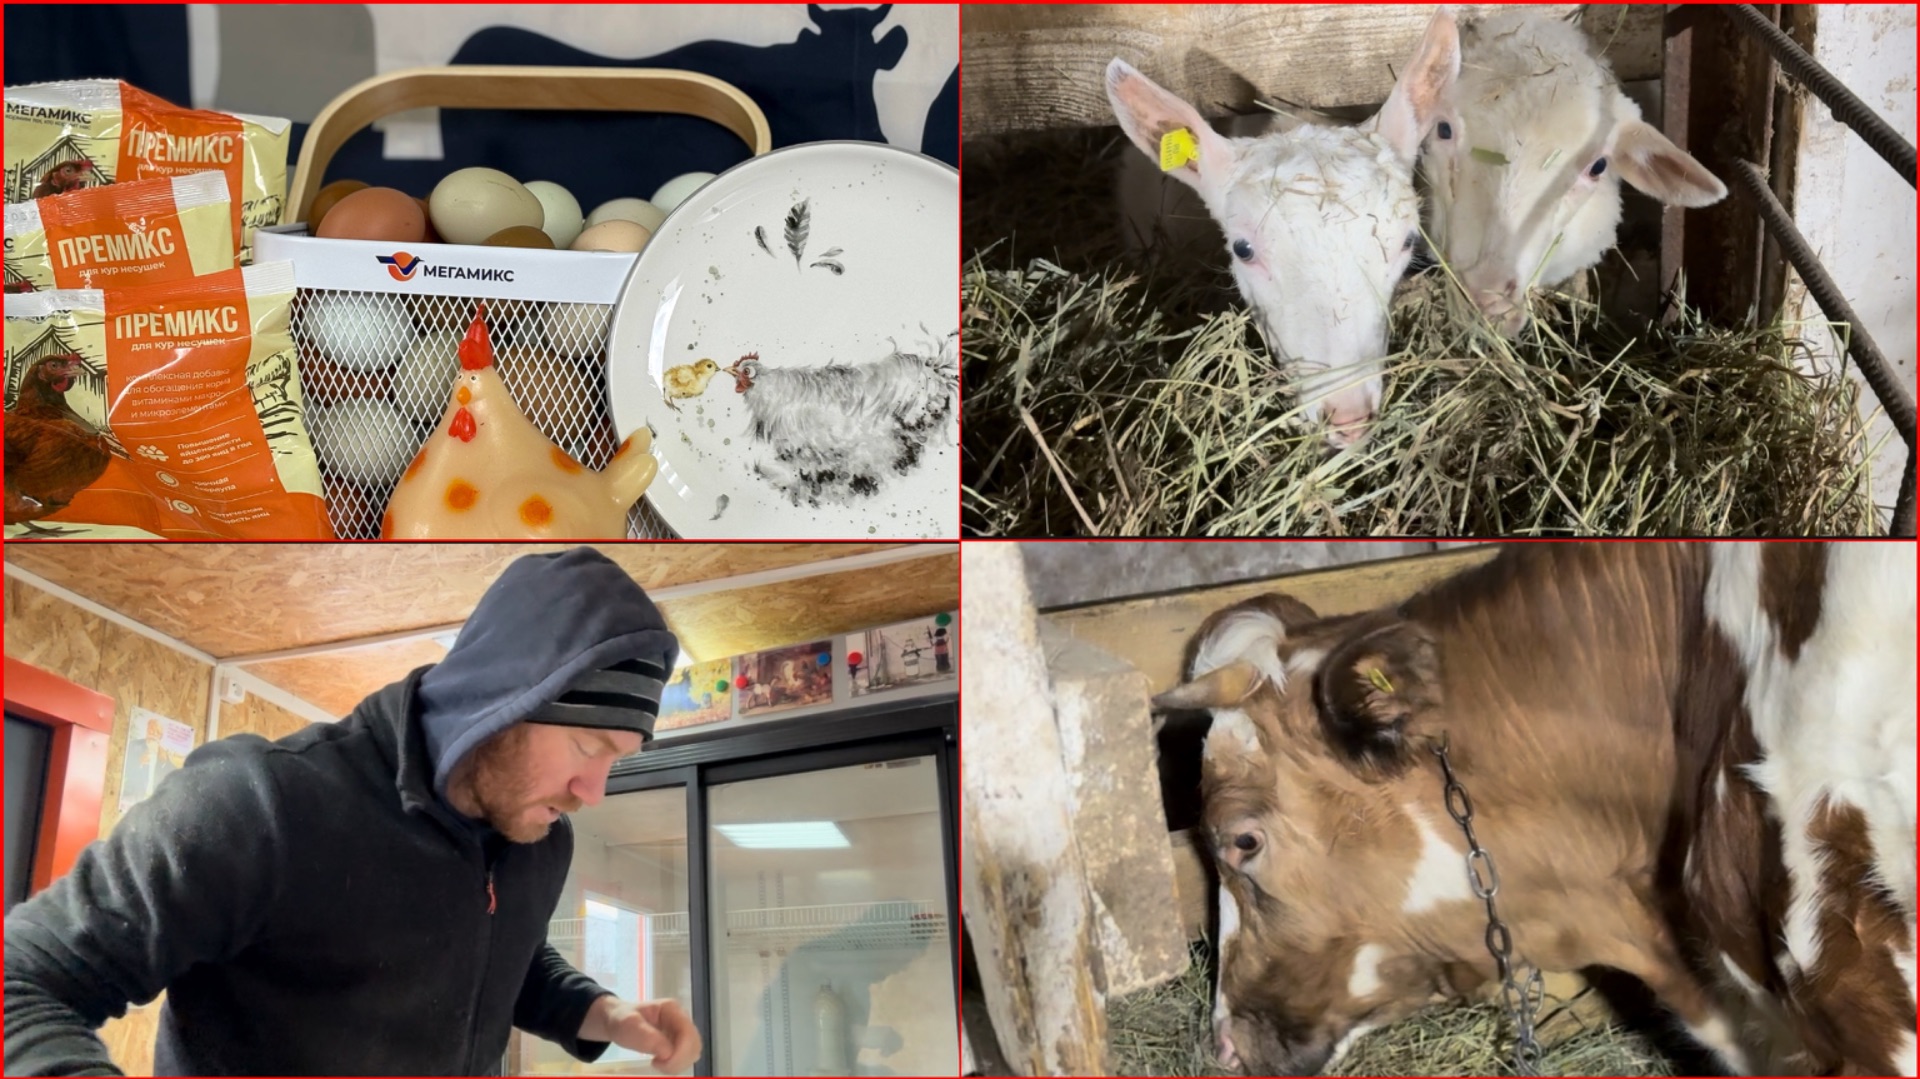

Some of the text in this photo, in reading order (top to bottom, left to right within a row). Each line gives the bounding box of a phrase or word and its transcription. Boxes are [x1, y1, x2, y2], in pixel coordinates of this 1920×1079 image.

[6, 102, 93, 124] МЕГАМИКС
[127, 129, 233, 164] ПРЕМИКС
[156, 165, 173, 174] кур
[57, 227, 175, 268] ПРЕМИКС
[101, 266, 119, 276] кур
[121, 261, 166, 273] несушек
[423, 264, 515, 282] МЕГАМИКС
[115, 306, 238, 339] ПРЕМИКС
[131, 338, 226, 352] для кур несушек
[144, 383, 204, 393] обогащения
[206, 378, 231, 388] корма
[132, 395, 193, 406] витаминами
[177, 433, 231, 449] Повышение
[237, 441, 253, 449] год
